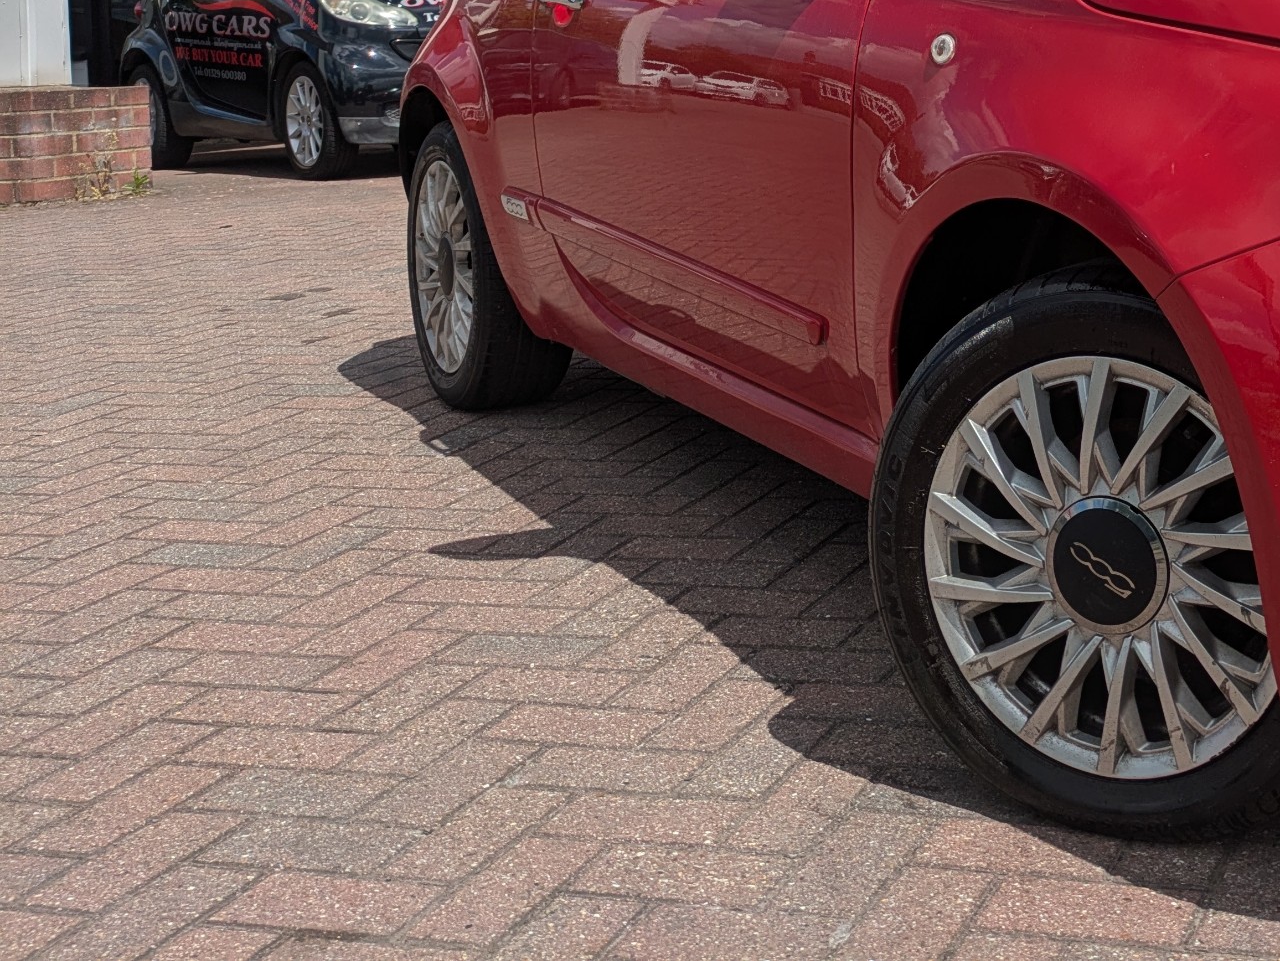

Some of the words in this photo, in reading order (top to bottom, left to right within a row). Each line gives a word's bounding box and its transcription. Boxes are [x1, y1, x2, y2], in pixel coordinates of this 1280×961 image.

[165, 11, 209, 35] OWG
[212, 14, 271, 38] CARS
[192, 47, 210, 62] BUY
[210, 48, 240, 64] YOUR
[240, 52, 263, 68] CAR
